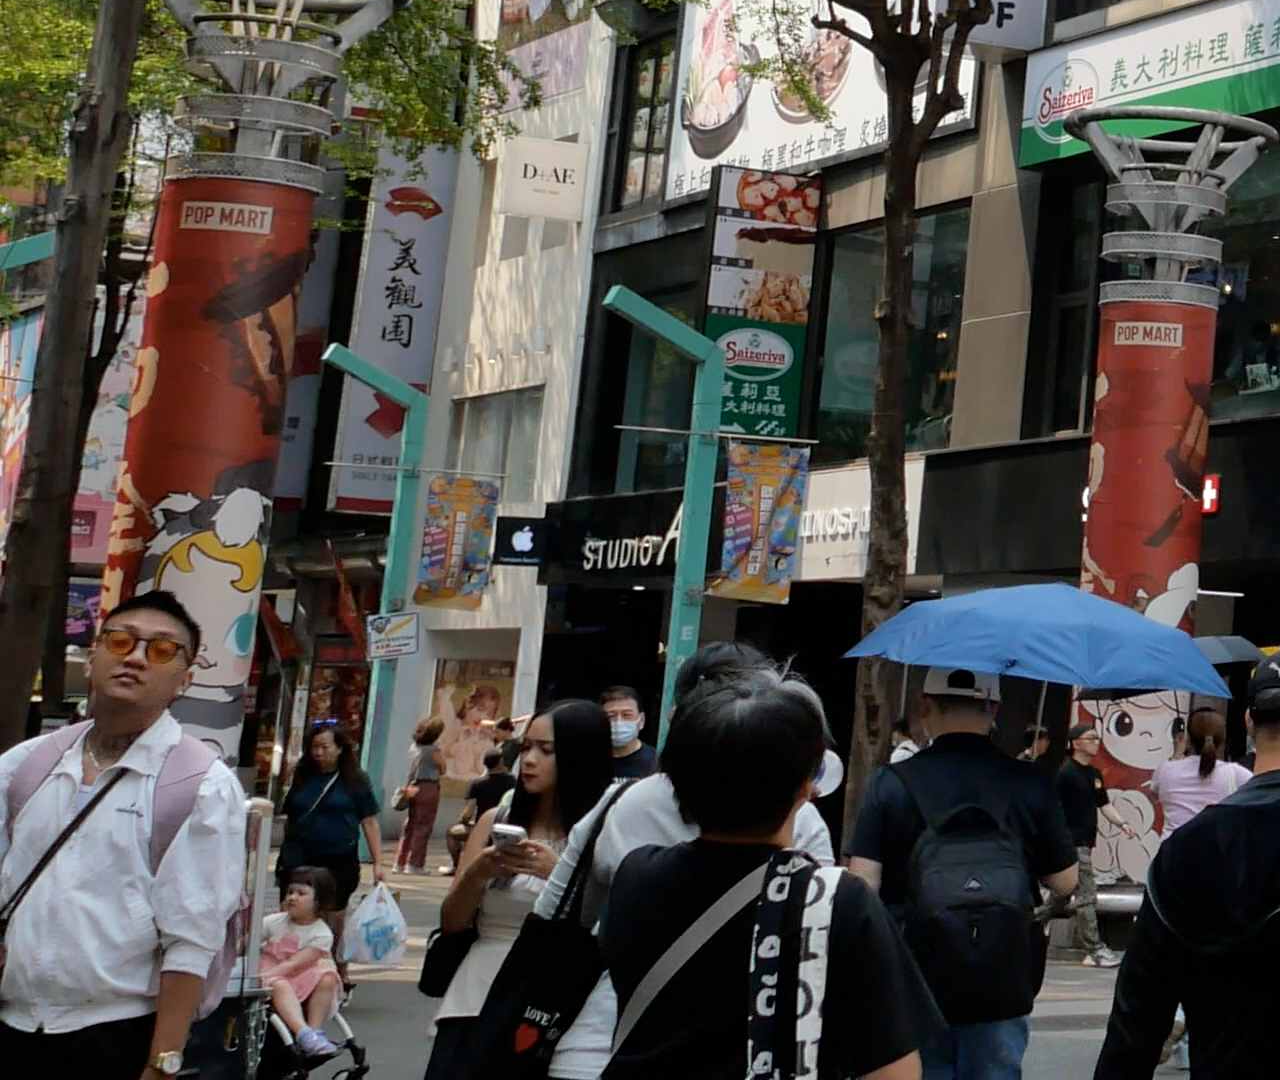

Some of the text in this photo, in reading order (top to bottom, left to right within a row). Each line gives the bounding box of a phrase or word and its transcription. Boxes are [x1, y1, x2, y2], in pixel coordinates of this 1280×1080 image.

[1109, 30, 1230, 93] 義大利料理
[1038, 85, 1094, 125] Saizeriya
[185, 204, 268, 231] POP MART
[1117, 325, 1181, 344] POP MART
[725, 341, 786, 366] Saizeriya
[583, 536, 651, 571] STUDIO
